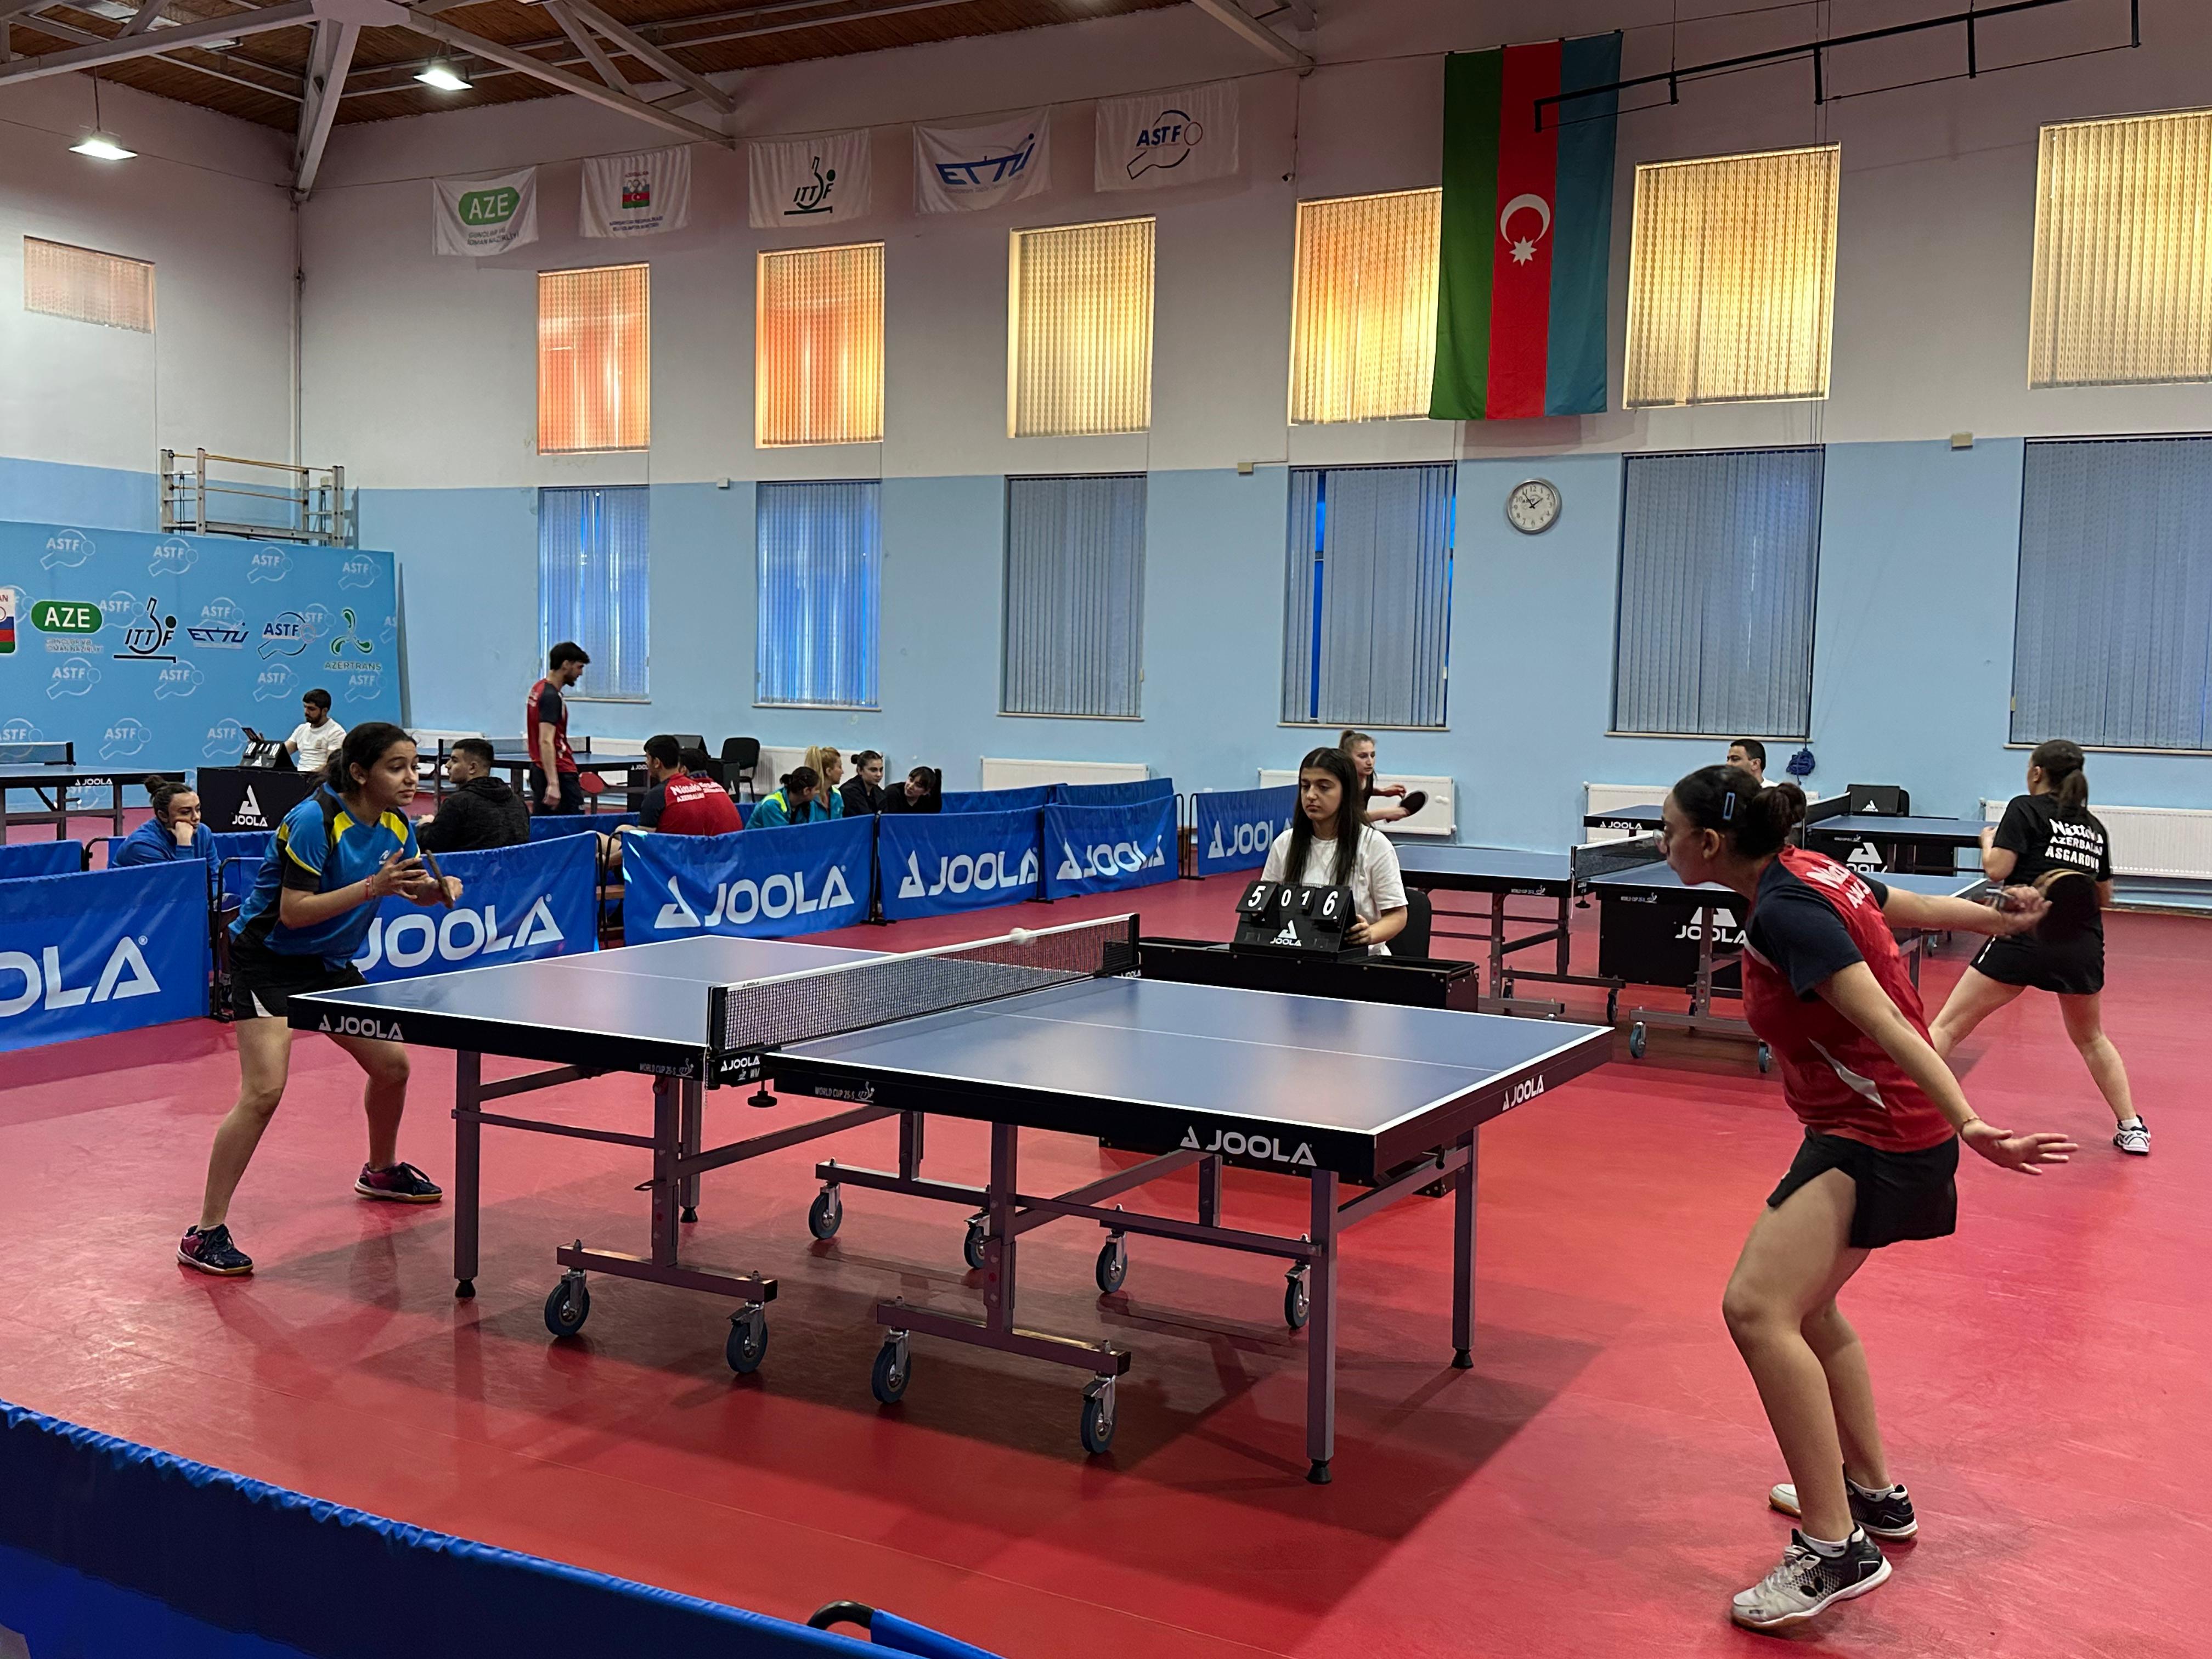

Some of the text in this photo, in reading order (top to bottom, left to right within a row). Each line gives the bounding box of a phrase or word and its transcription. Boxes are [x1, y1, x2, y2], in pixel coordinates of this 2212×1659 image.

[1136, 125, 1182, 146] ASTF
[935, 143, 1035, 185] ETTU
[793, 182, 834, 202] ITTF
[469, 193, 509, 219] AZE
[46, 537, 80, 551] ASTF
[153, 545, 184, 558] ASTF
[251, 554, 280, 567] ASTF
[342, 562, 369, 573] ASTF
[44, 607, 90, 628] AZE
[201, 606, 232, 617] ASTF
[263, 623, 299, 636] ASTF
[125, 629, 174, 646] ITTF
[325, 662, 381, 670] AZERTRANS
[52, 667, 86, 679] ASTF
[159, 669, 190, 681] ASTF
[258, 673, 286, 684] ASTF
[349, 675, 375, 686] ASTF
[104, 728, 137, 740] ASTF
[207, 728, 236, 740] ASTF
[232, 815, 268, 827] JOOLA
[1607, 821, 1643, 830] JOOLA
[928, 848, 1039, 896] JOOLA
[705, 865, 855, 927] JOOLA
[1248, 885, 1339, 916] 5 0 1 6
[352, 896, 565, 972] JOOLA
[1270, 937, 1302, 947] JOOLA
[334, 1015, 404, 1041] JOOLA
[729, 1055, 760, 1070] JOOLA
[1510, 1075, 1544, 1107] JOOLA
[1205, 1130, 1317, 1167] JOOLA
